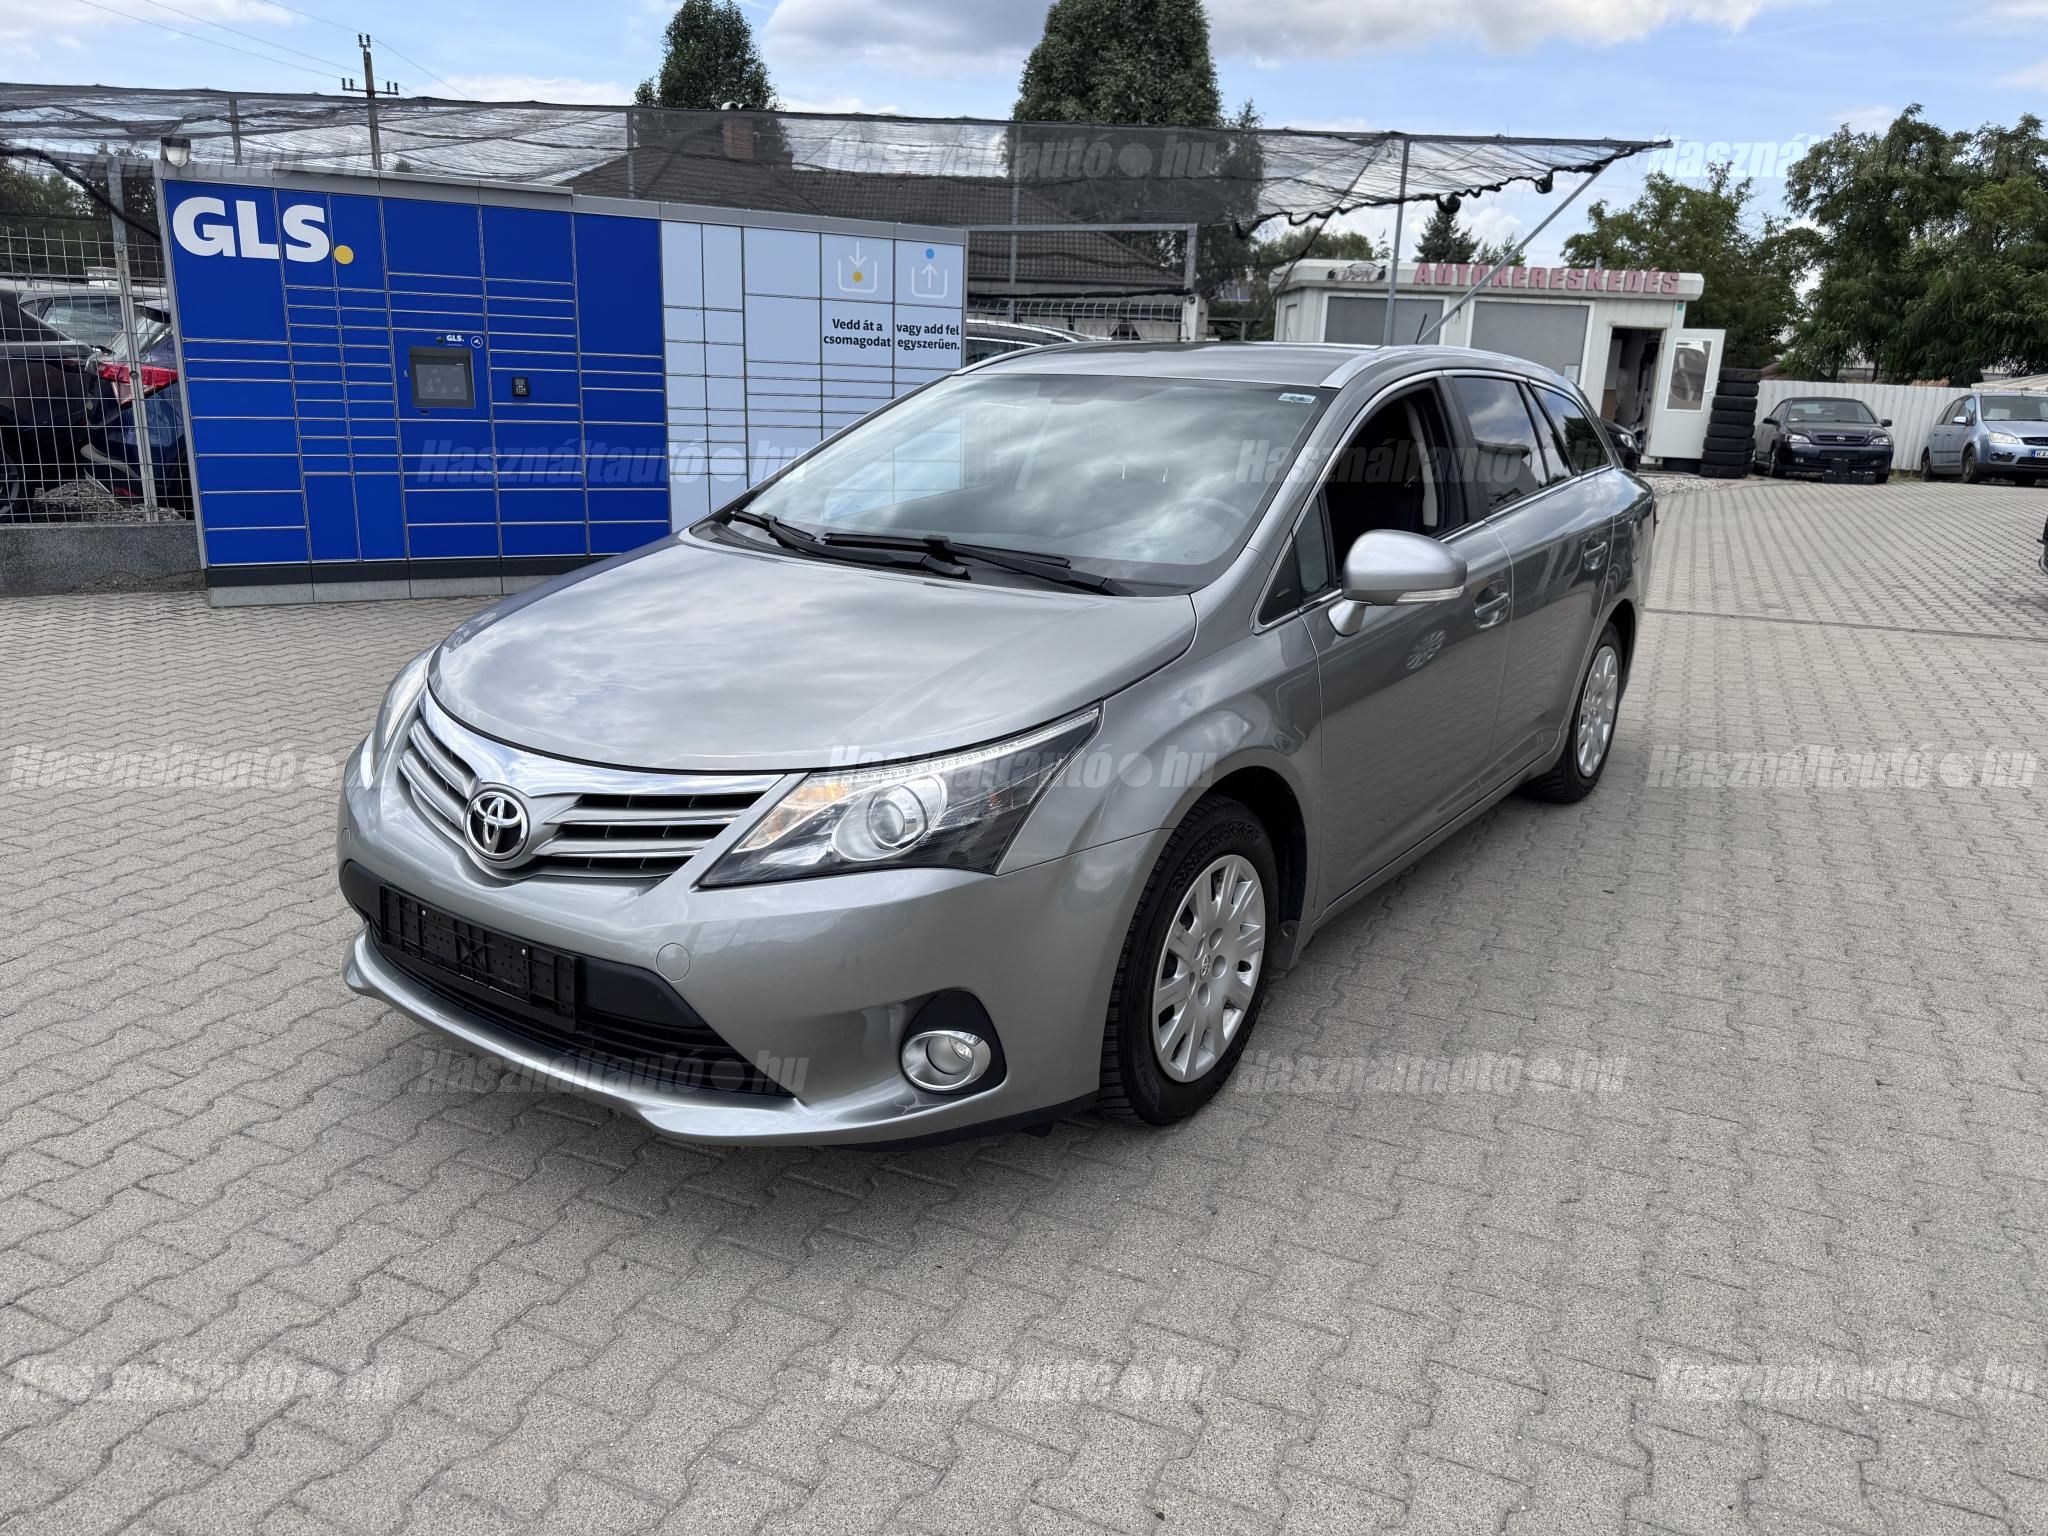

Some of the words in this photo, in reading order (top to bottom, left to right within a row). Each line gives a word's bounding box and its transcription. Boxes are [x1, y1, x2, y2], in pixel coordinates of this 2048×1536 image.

[832, 318, 861, 330] Vedd
[863, 319, 874, 331] át
[876, 322, 883, 332] a
[896, 323, 922, 337] vagy
[924, 324, 943, 335] add
[945, 325, 960, 336] fel
[823, 335, 891, 349] csomagodat
[897, 337, 961, 351] egyszerűen.
